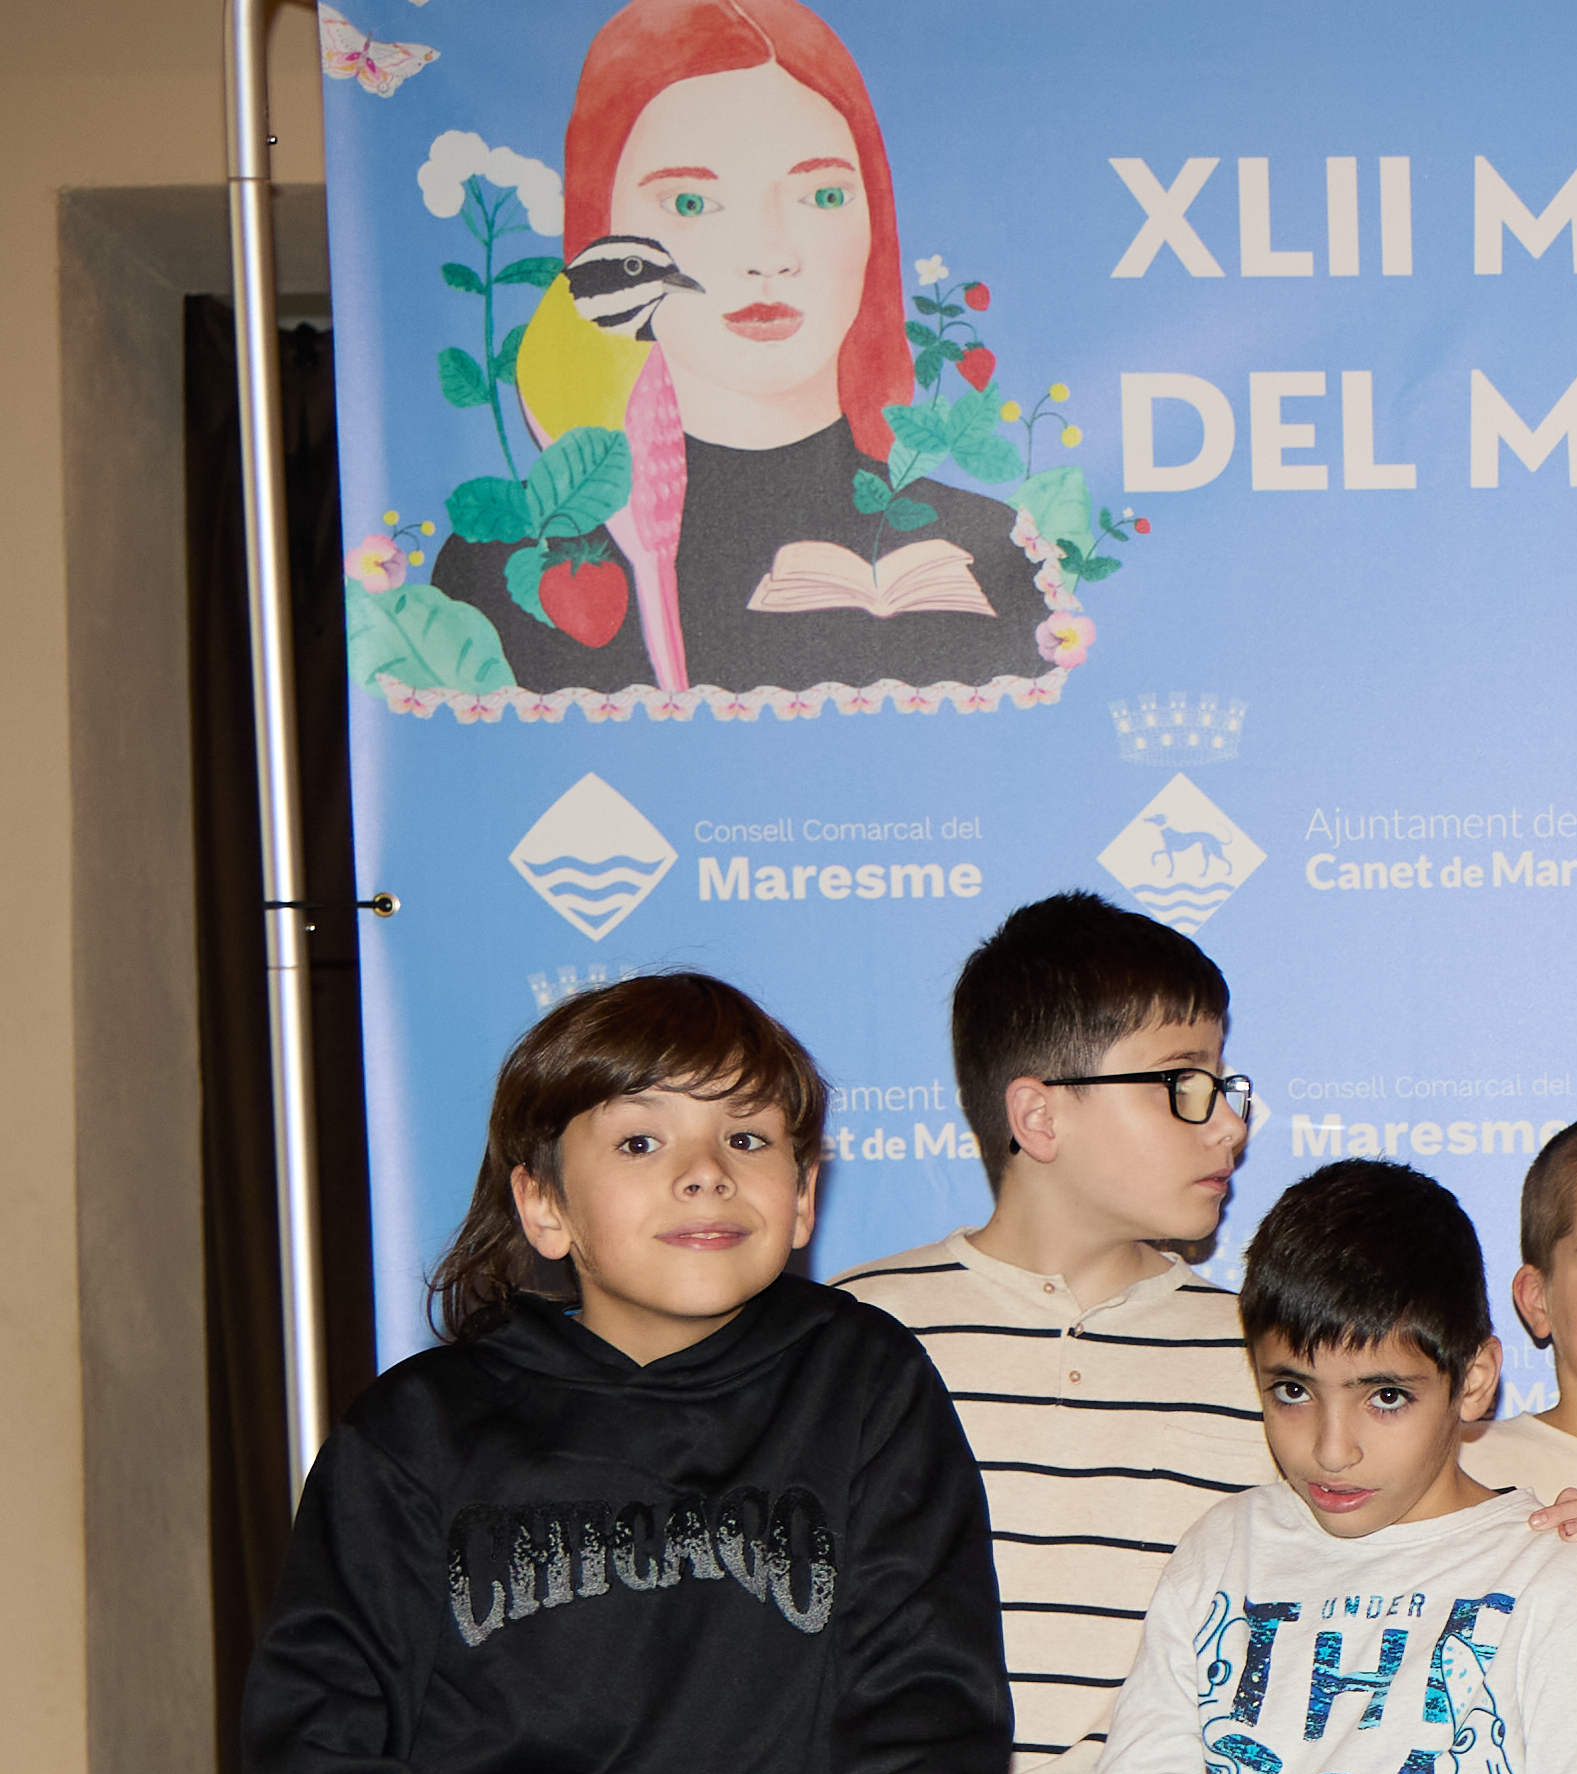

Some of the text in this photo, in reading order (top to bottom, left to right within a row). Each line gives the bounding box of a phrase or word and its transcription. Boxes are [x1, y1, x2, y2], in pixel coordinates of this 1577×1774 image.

[1110, 157, 1414, 279] XLII
[1122, 371, 1418, 493] DEL
[696, 817, 983, 844] Consell Comarcal del
[1307, 806, 1577, 849] Ajuntament de
[700, 858, 983, 901] Maresme
[1307, 854, 1433, 890] Canet
[1441, 858, 1485, 889] de
[830, 1079, 946, 1112] ament
[1289, 1072, 1573, 1100] Consell Comarcal del
[862, 1128, 907, 1160] de
[914, 1122, 981, 1160] Ma
[447, 1486, 836, 1647] CHICAGO
[1322, 1593, 1426, 1619] UNDER
[1229, 1593, 1516, 1741] THE
